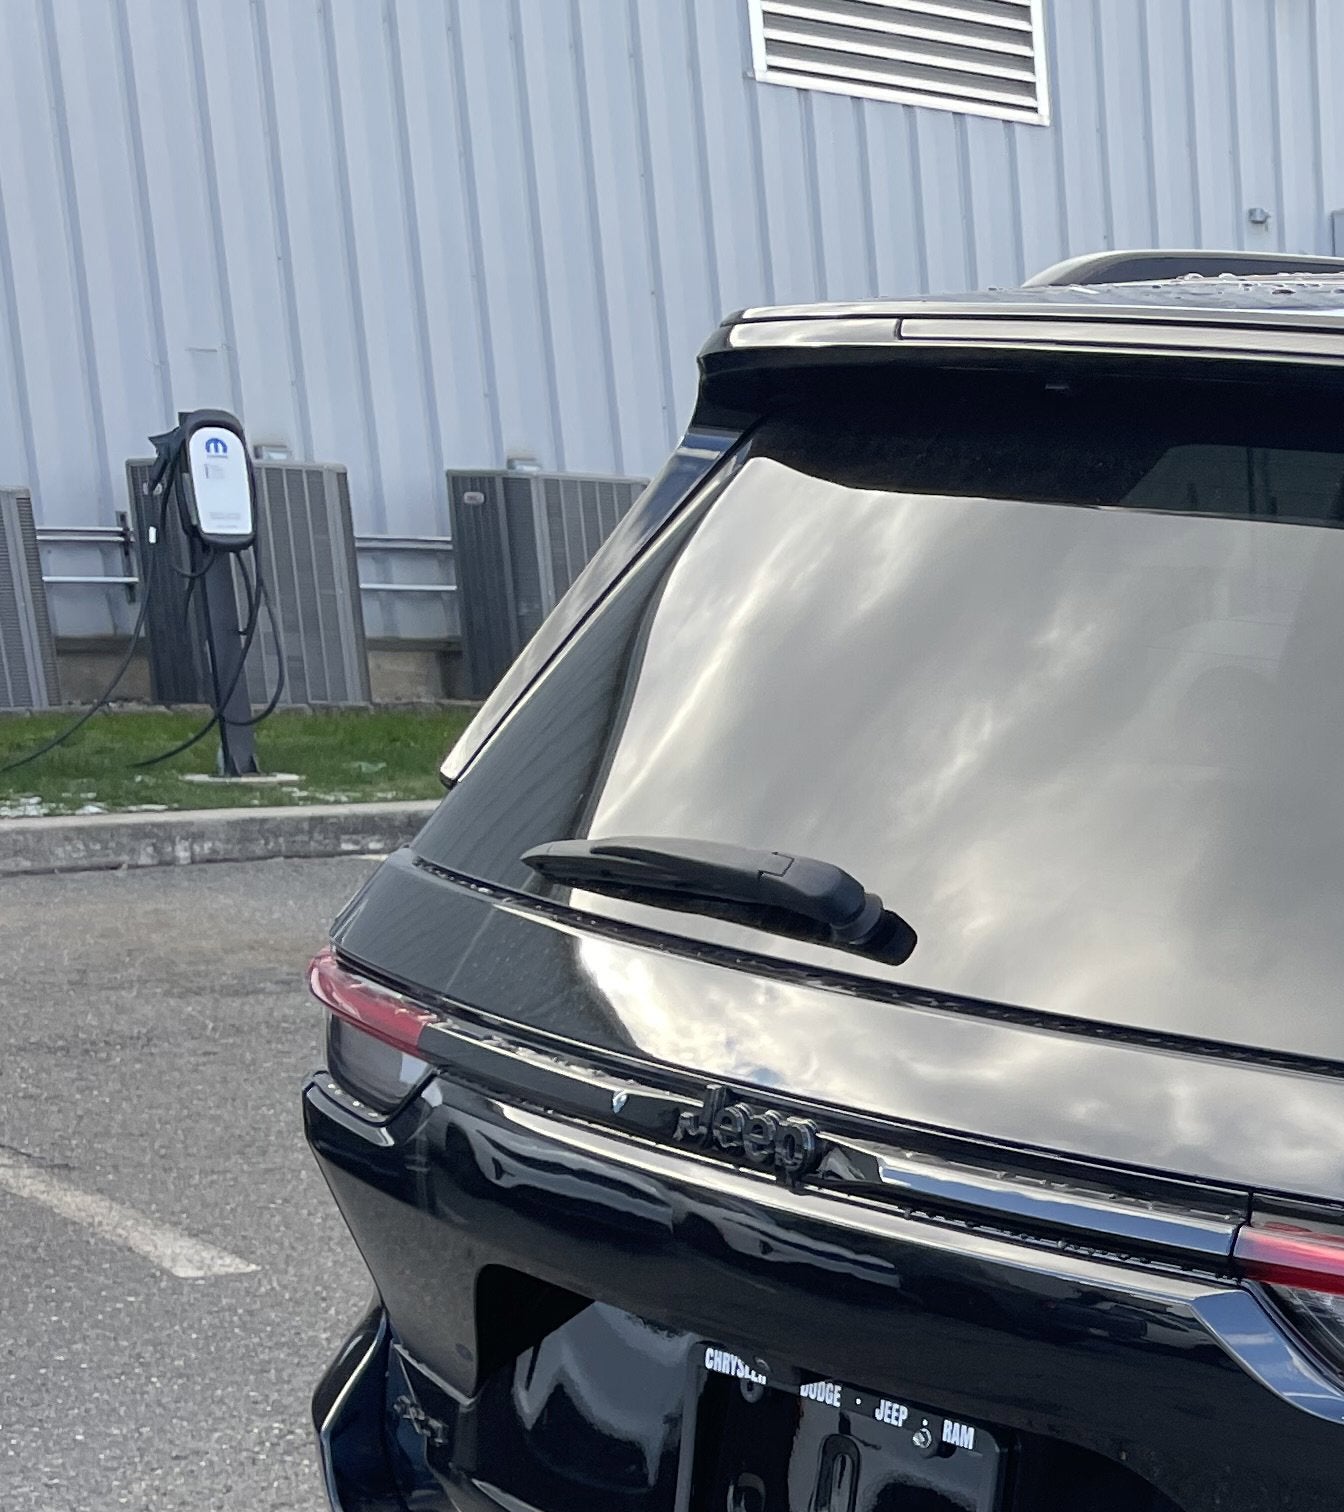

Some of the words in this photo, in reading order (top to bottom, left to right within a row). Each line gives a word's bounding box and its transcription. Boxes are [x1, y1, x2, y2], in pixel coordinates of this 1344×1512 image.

[800, 1381, 842, 1408] DODGE
[875, 1399, 908, 1427] JEEP
[942, 1418, 975, 1450] RAM
